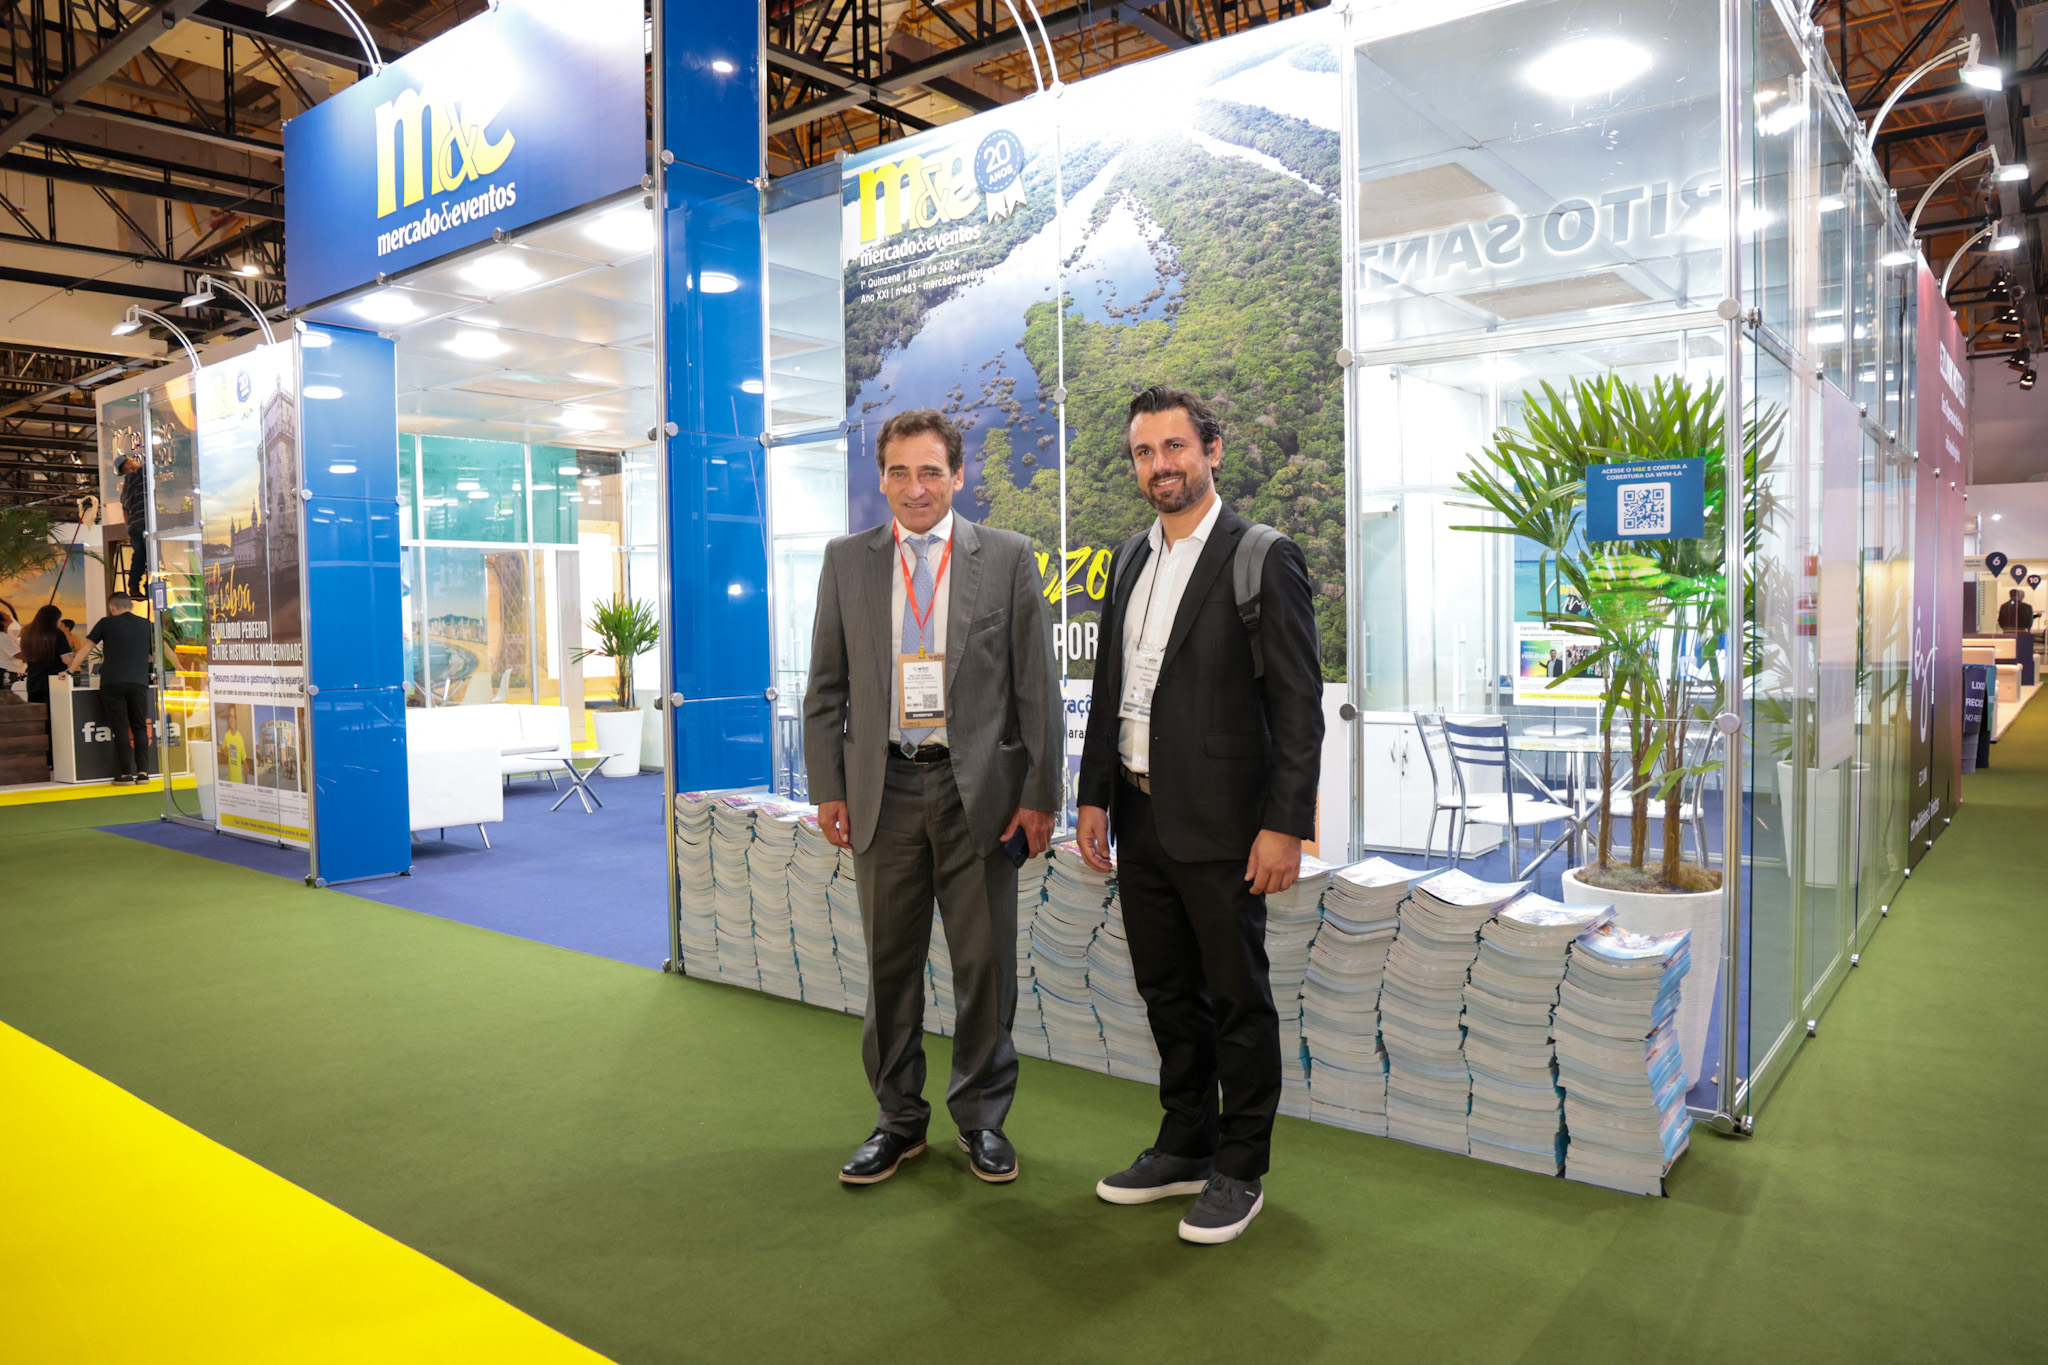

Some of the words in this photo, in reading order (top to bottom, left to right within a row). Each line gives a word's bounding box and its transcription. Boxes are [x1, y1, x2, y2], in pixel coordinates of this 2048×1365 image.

[983, 138, 1012, 174] 20
[988, 163, 1014, 186] ANOS
[859, 147, 982, 244] m&e
[377, 181, 517, 257] mercado&eventos
[860, 224, 981, 268] mercado&eventos
[868, 274, 901, 288] Quinzena
[907, 266, 926, 279] Abril
[927, 264, 938, 274] de
[939, 258, 960, 272] 2024
[861, 293, 875, 305] Ano
[876, 289, 889, 300] XXI
[1602, 467, 1625, 475] ACESSE
[1992, 556, 2001, 566] 6
[2015, 568, 2022, 576] 8
[241, 621, 267, 639] PERFEITO
[212, 644, 228, 661] ENTRE
[228, 639, 254, 661] HISTÓRIA
[255, 644, 259, 661] E
[260, 643, 302, 662] MODERNIDADE
